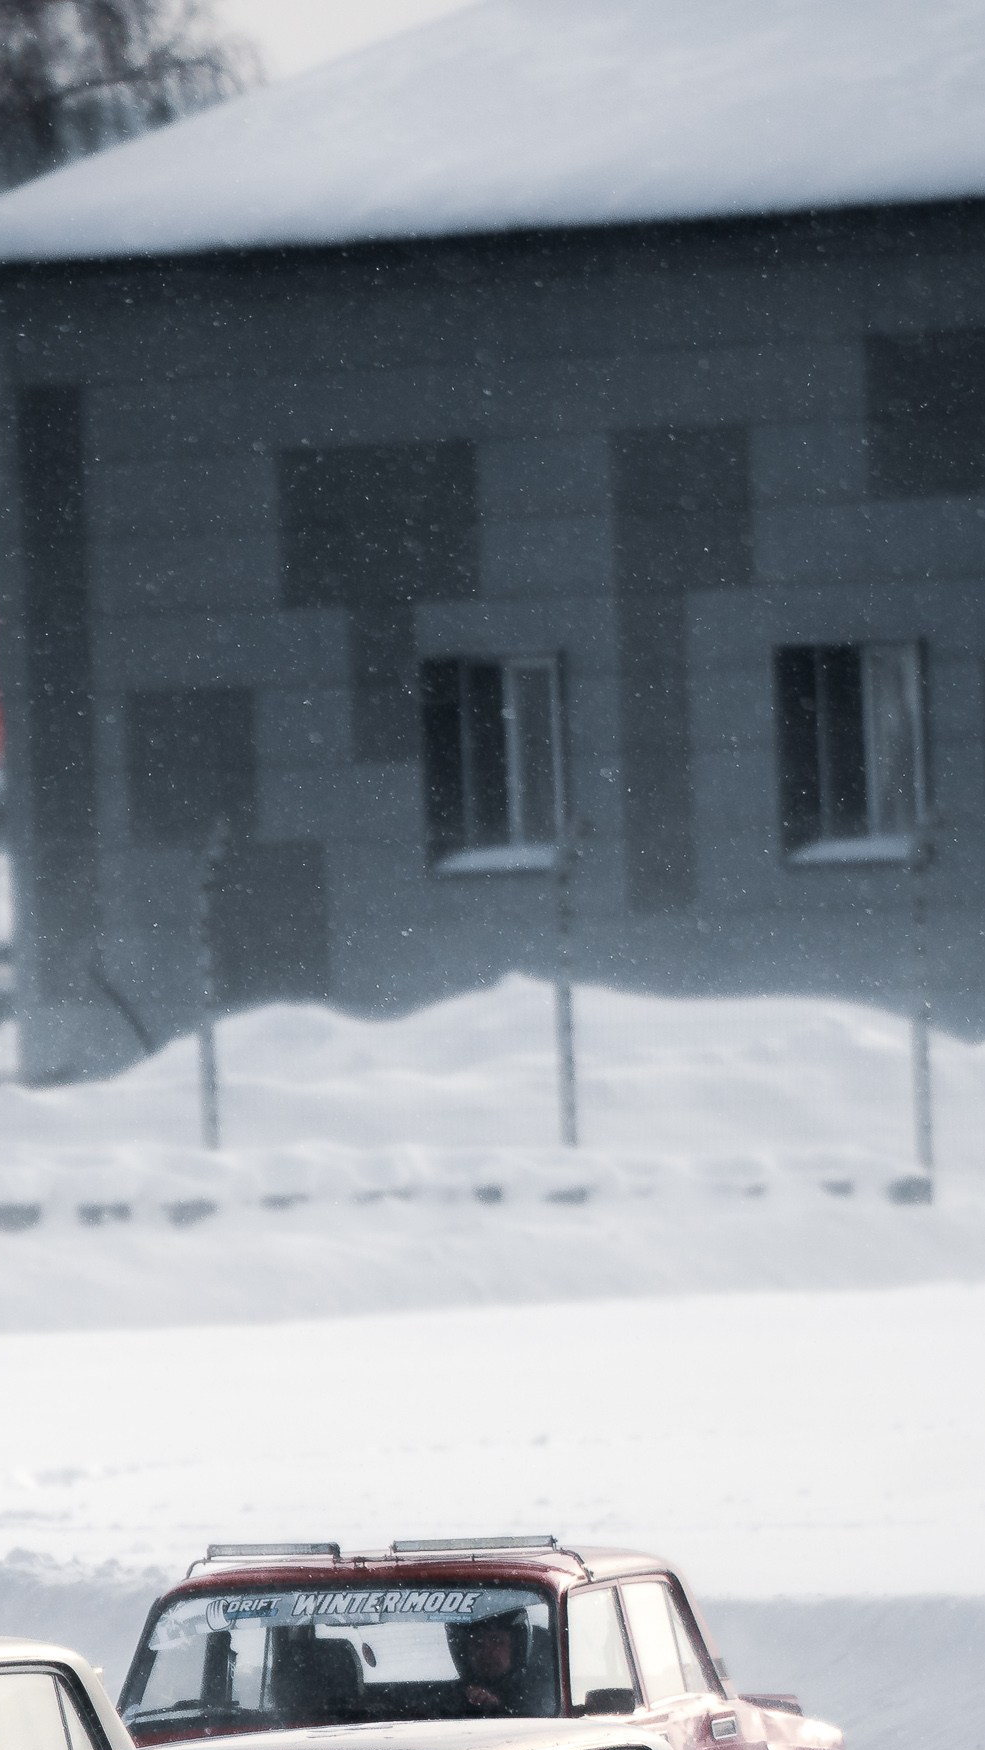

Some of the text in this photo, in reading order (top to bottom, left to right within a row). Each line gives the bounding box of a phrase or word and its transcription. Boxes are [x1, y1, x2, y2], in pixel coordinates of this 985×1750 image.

[227, 1597, 282, 1613] DRIFT
[291, 1590, 483, 1617] WINTER MODE
